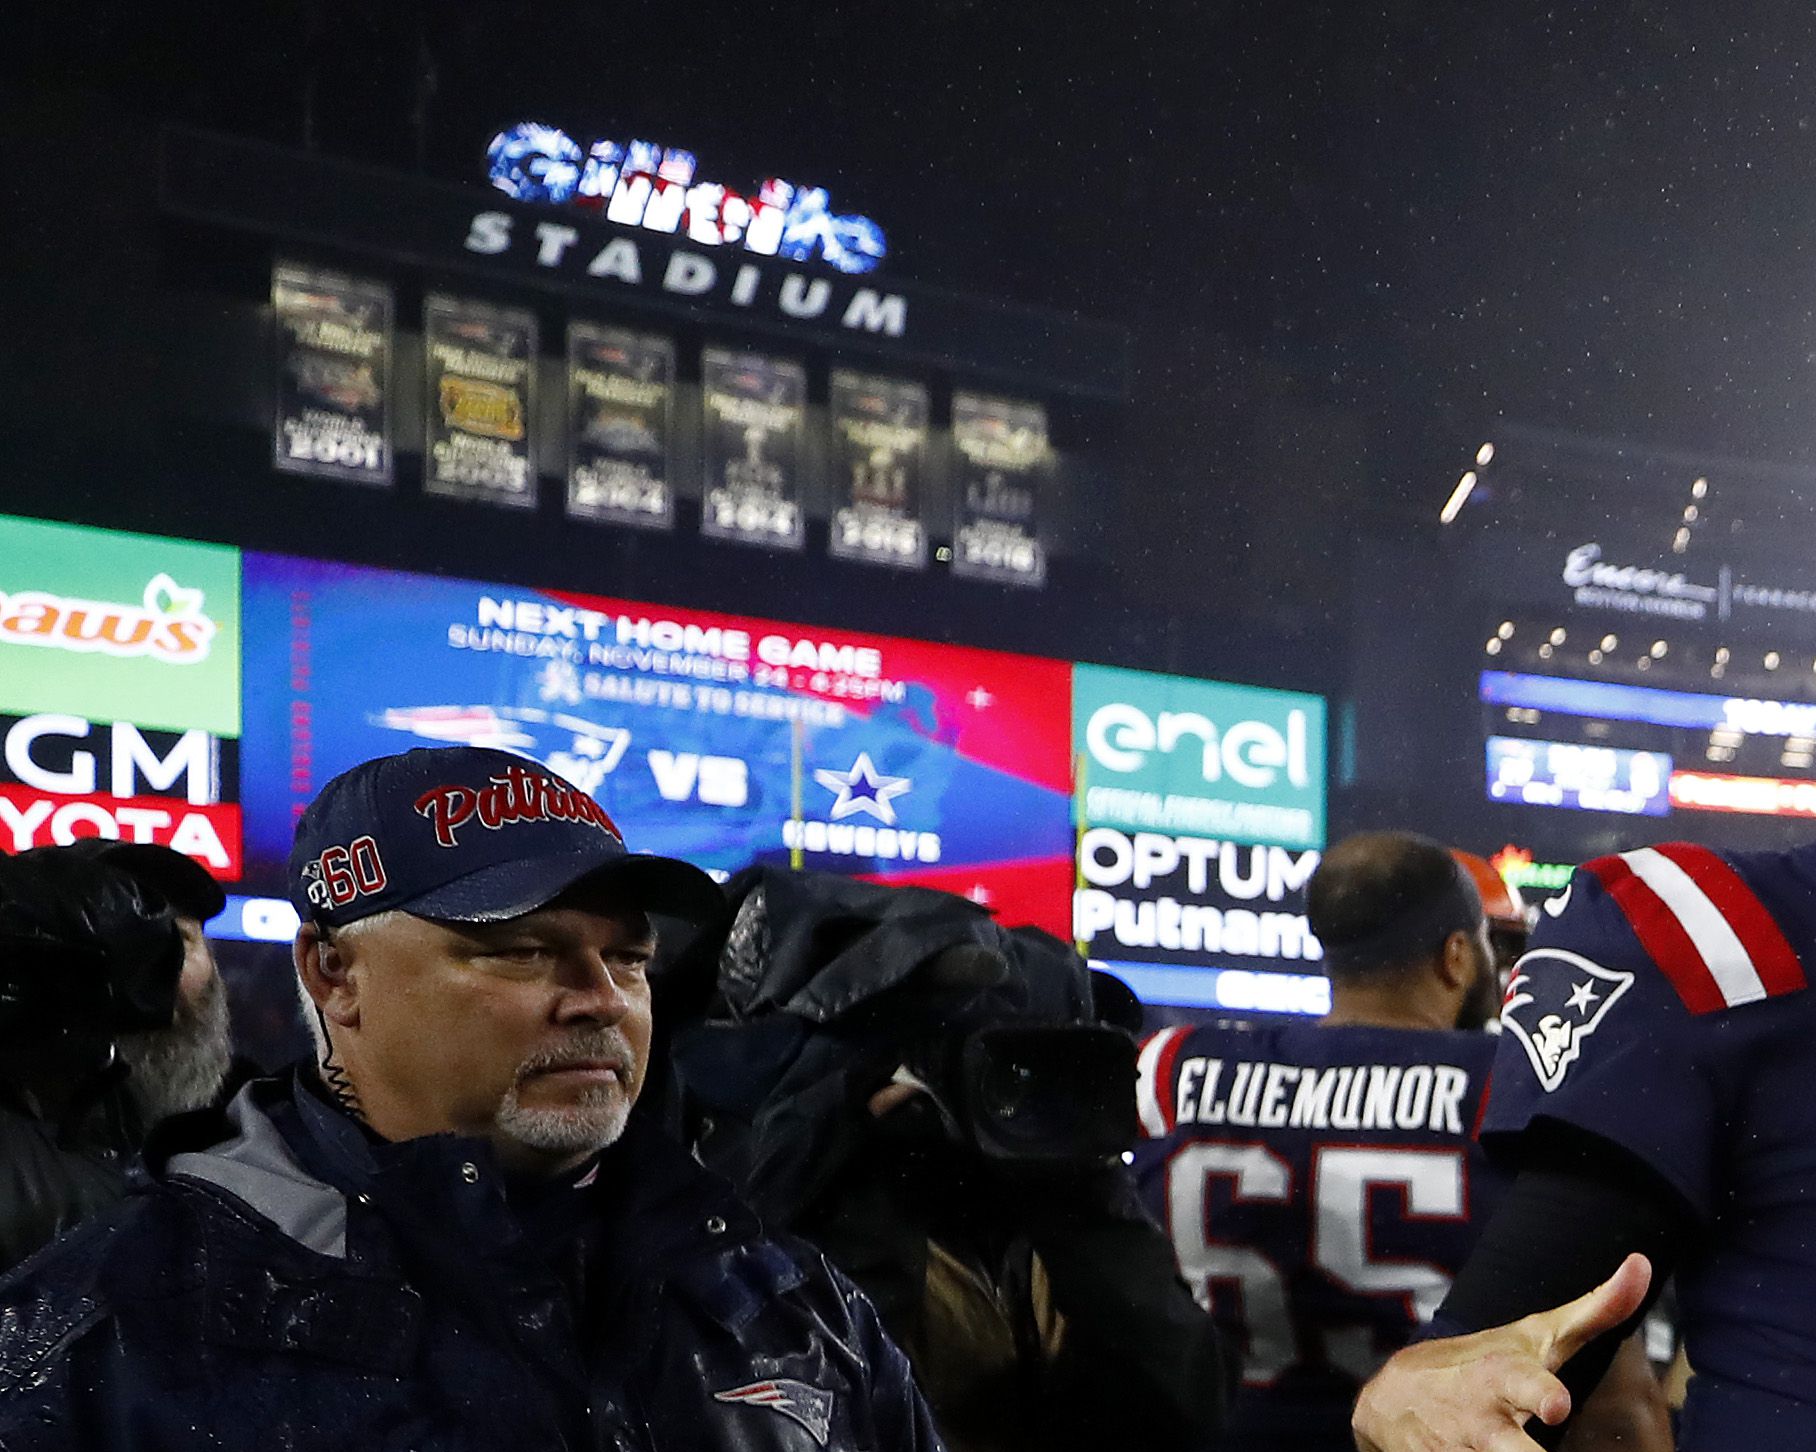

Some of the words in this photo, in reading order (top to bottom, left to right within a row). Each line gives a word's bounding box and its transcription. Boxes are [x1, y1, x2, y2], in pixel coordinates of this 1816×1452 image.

[465, 211, 907, 336] STADIUM
[448, 623, 583, 664] SUNDAY,
[589, 643, 750, 683] NOVEMBER
[478, 596, 606, 640] NEXT
[616, 615, 750, 661] HOME
[758, 635, 882, 678] GAME
[4, 712, 212, 807] GM
[647, 749, 749, 808] VS
[1087, 703, 1309, 788] enel
[321, 835, 387, 907] 60
[1079, 827, 1321, 901] OPTUM
[1073, 888, 1324, 961] Putnam
[1175, 1057, 1470, 1135] ELUEMUNOR
[1164, 1139, 1471, 1388] 65
